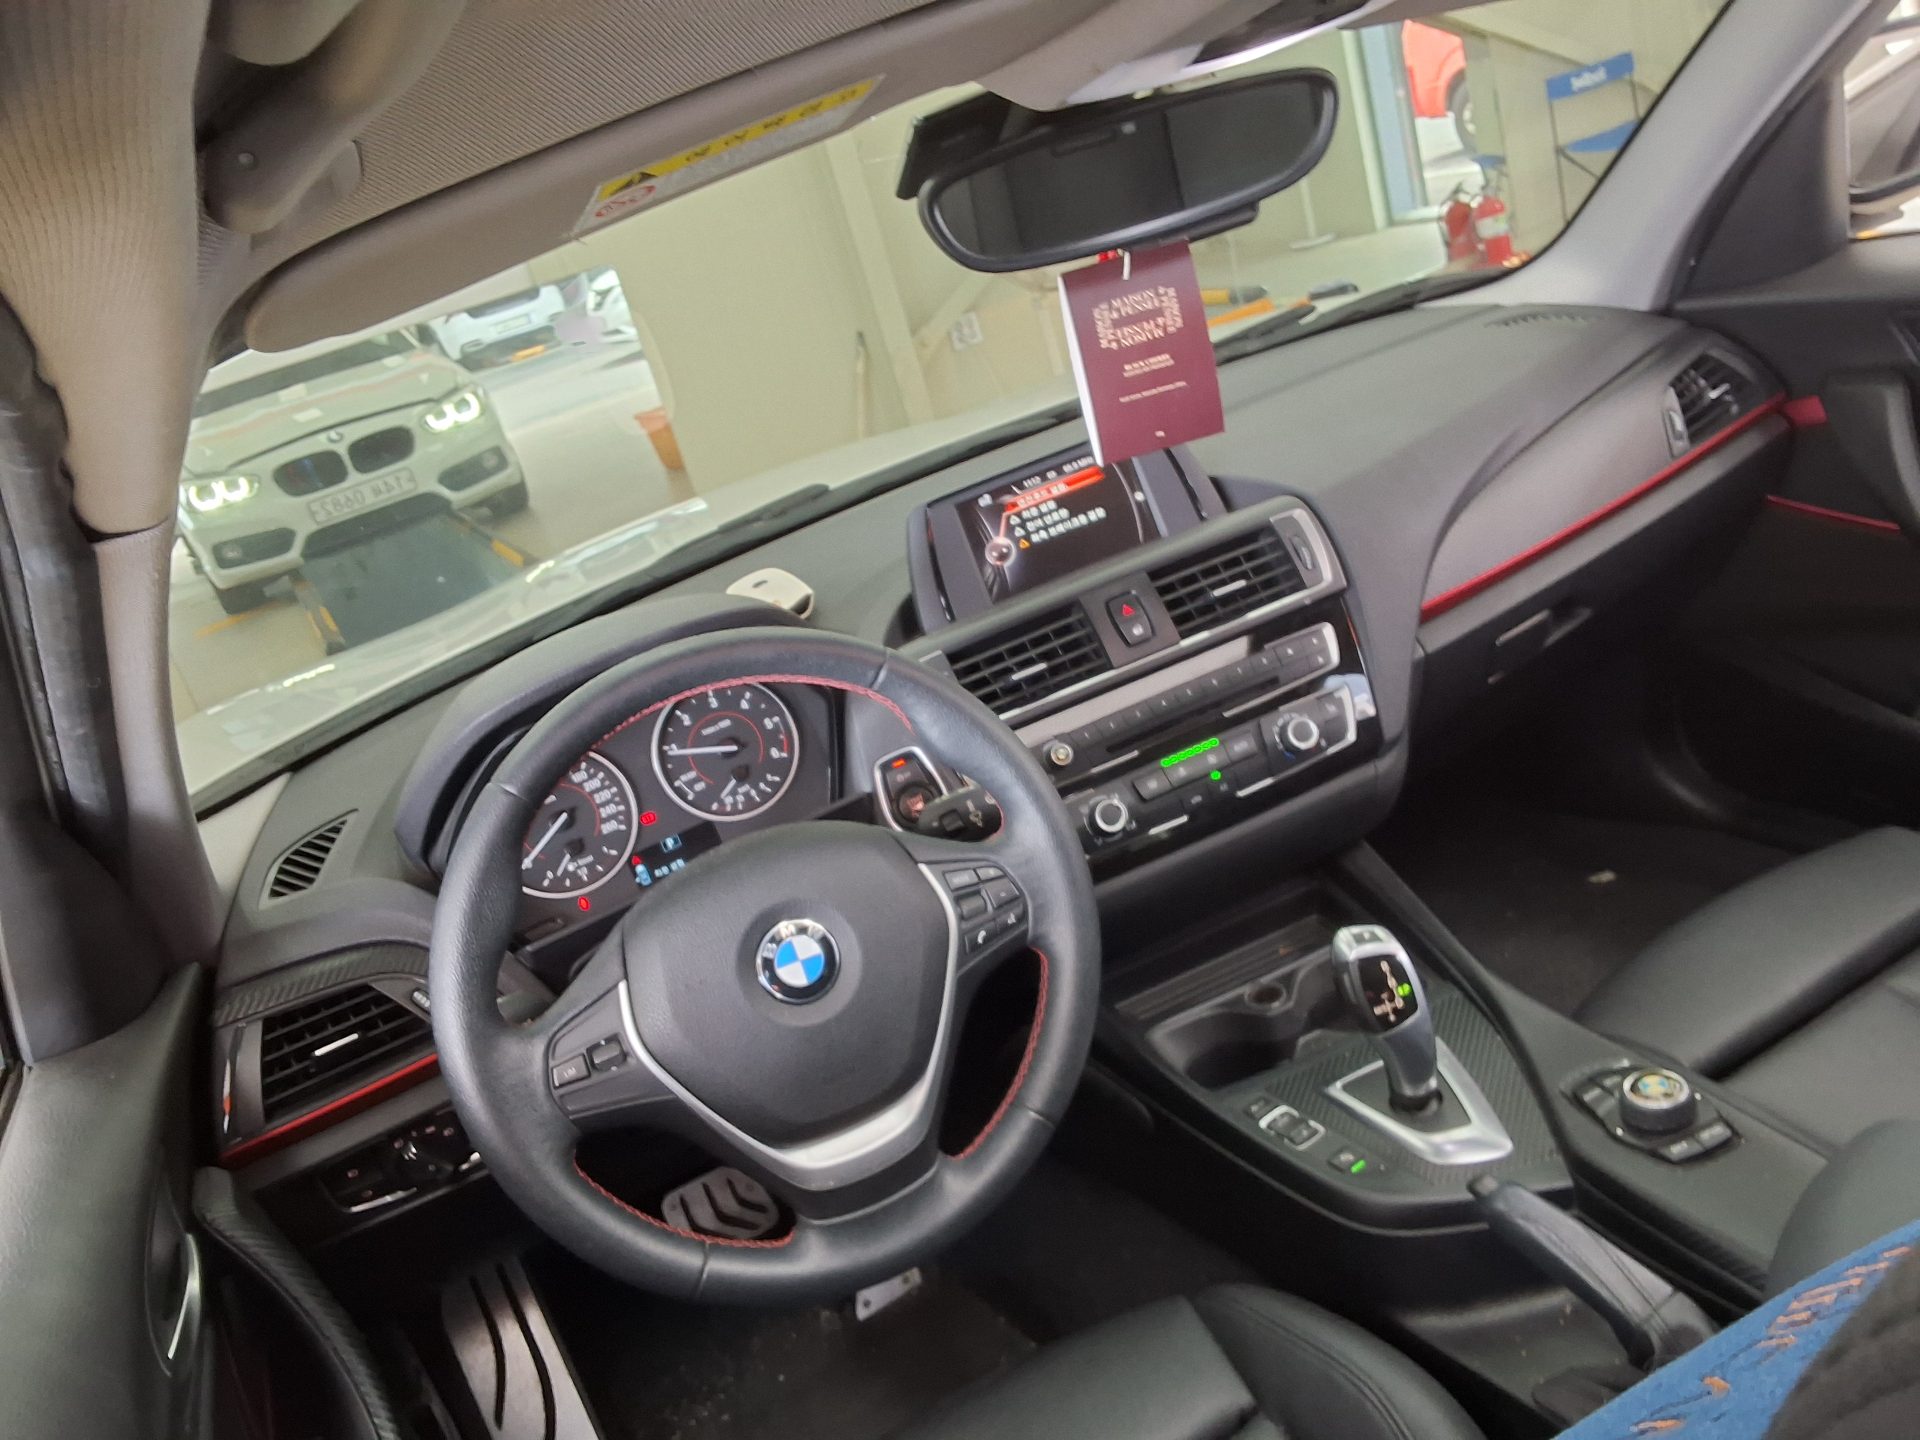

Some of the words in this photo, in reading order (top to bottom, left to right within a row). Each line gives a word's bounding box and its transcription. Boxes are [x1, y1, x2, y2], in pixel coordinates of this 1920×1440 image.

[583, 778, 601, 792] 200
[593, 788, 612, 804] 220
[599, 803, 617, 818] 240
